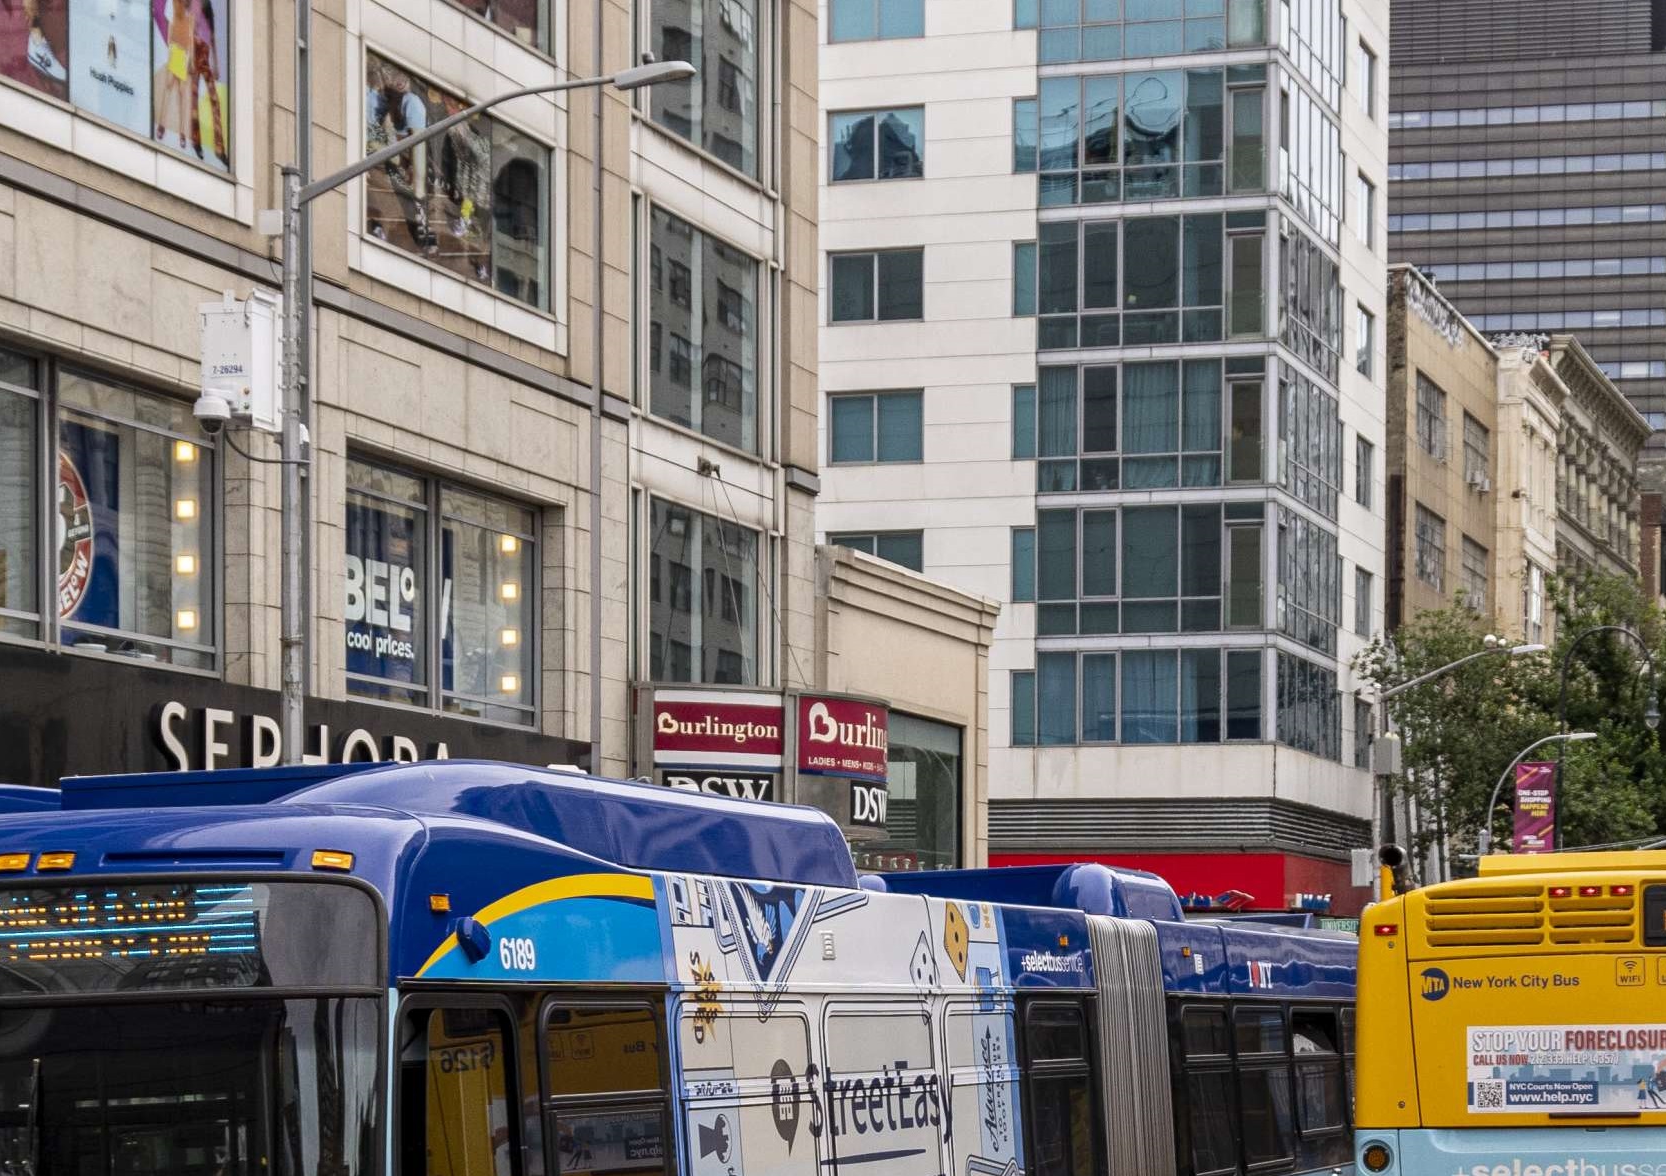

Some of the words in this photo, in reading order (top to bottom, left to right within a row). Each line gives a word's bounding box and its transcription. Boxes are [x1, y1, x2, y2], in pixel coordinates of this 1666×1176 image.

[346, 630, 372, 651] cool
[657, 711, 779, 743] Burlington
[808, 756, 836, 768] LADIES
[1321, 918, 1359, 932] UNIVERSIT
[499, 937, 535, 971] 6189
[1452, 977, 1481, 989] New
[1483, 975, 1518, 988] York
[1521, 974, 1550, 991] City
[1553, 974, 1581, 987] Bus
[1619, 975, 1641, 984] WIFI
[1472, 1030, 1517, 1053] STOP
[1516, 1029, 1562, 1052] YOUR
[1473, 1054, 1495, 1066] CALL
[1495, 1054, 1508, 1066] US
[1508, 1054, 1529, 1066] NOW
[1509, 1083, 1527, 1091] NYC
[1527, 1083, 1554, 1091] Courts
[1554, 1083, 1572, 1091] Now
[1572, 1083, 1594, 1092] Open
[805, 1060, 955, 1145] StreetEasy
[1509, 1091, 1594, 1104] www.help.nyc
